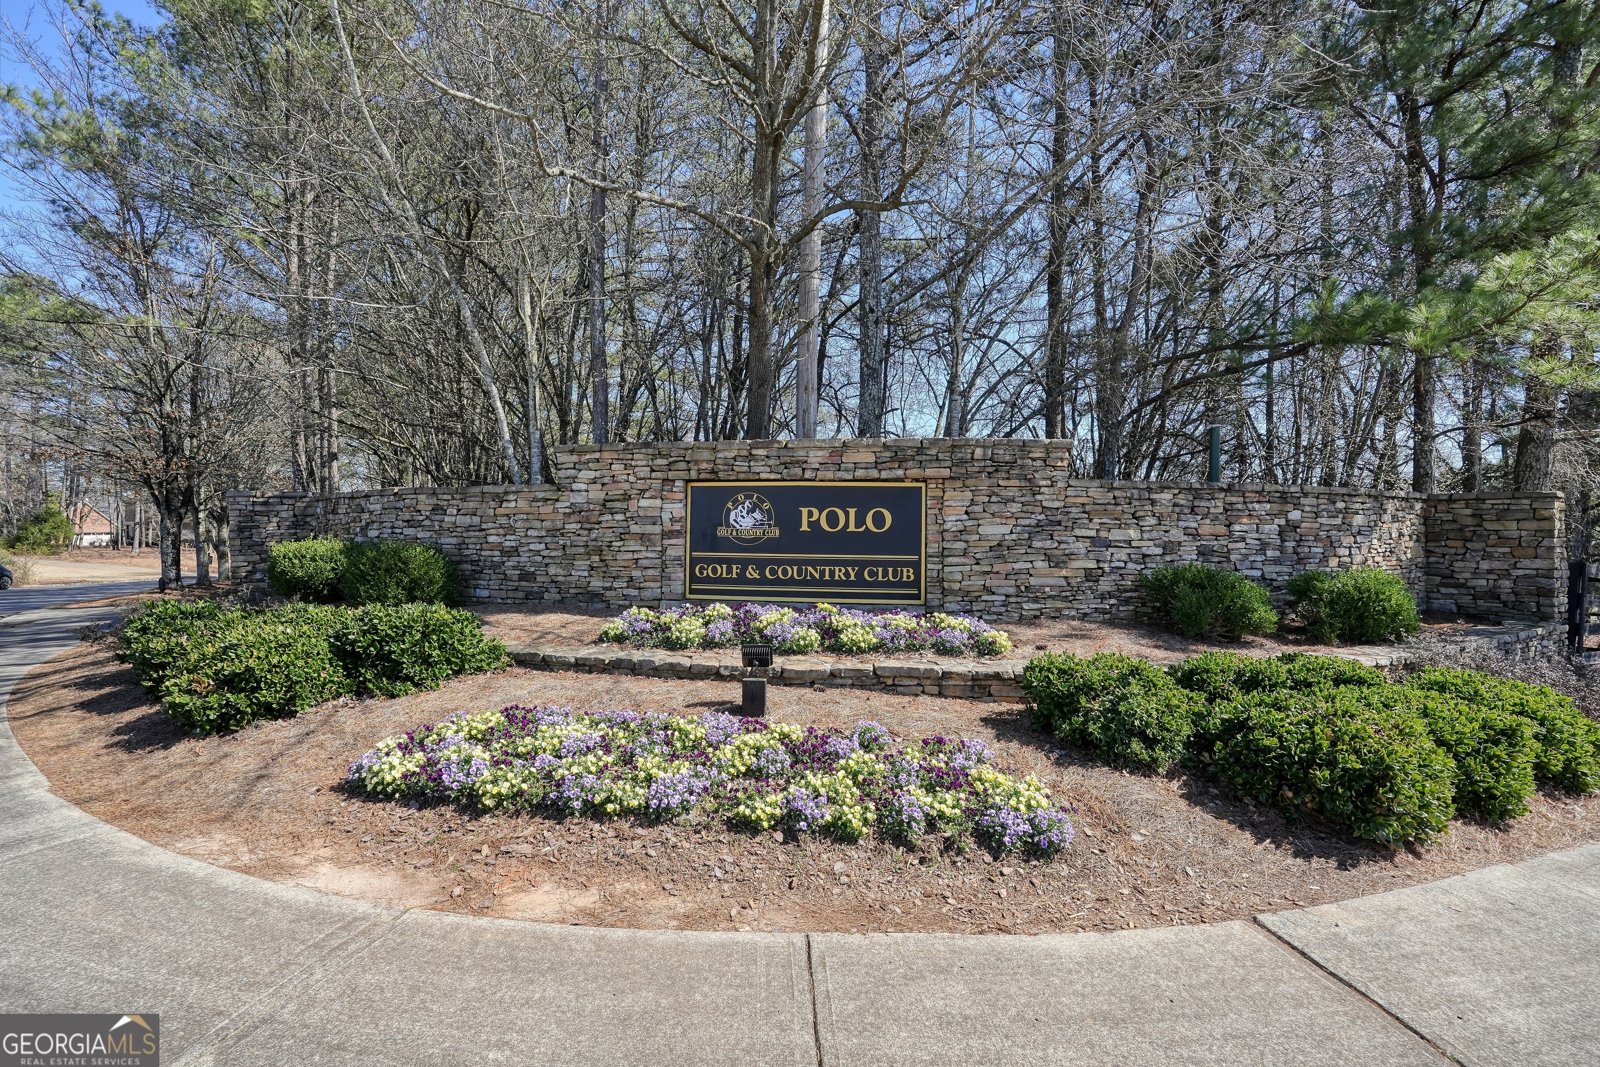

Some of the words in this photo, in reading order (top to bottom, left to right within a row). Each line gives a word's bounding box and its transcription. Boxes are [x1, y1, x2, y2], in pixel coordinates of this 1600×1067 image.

[727, 494, 769, 510] POLO
[799, 507, 892, 533] POLO
[716, 528, 731, 536] GOLF
[732, 528, 737, 536] &
[738, 528, 763, 536] COUNTRY
[765, 528, 780, 536] CLUB
[695, 563, 741, 578] GOLF
[745, 565, 760, 579] &
[765, 565, 859, 581] COUNTRY
[864, 567, 915, 582] CLUB
